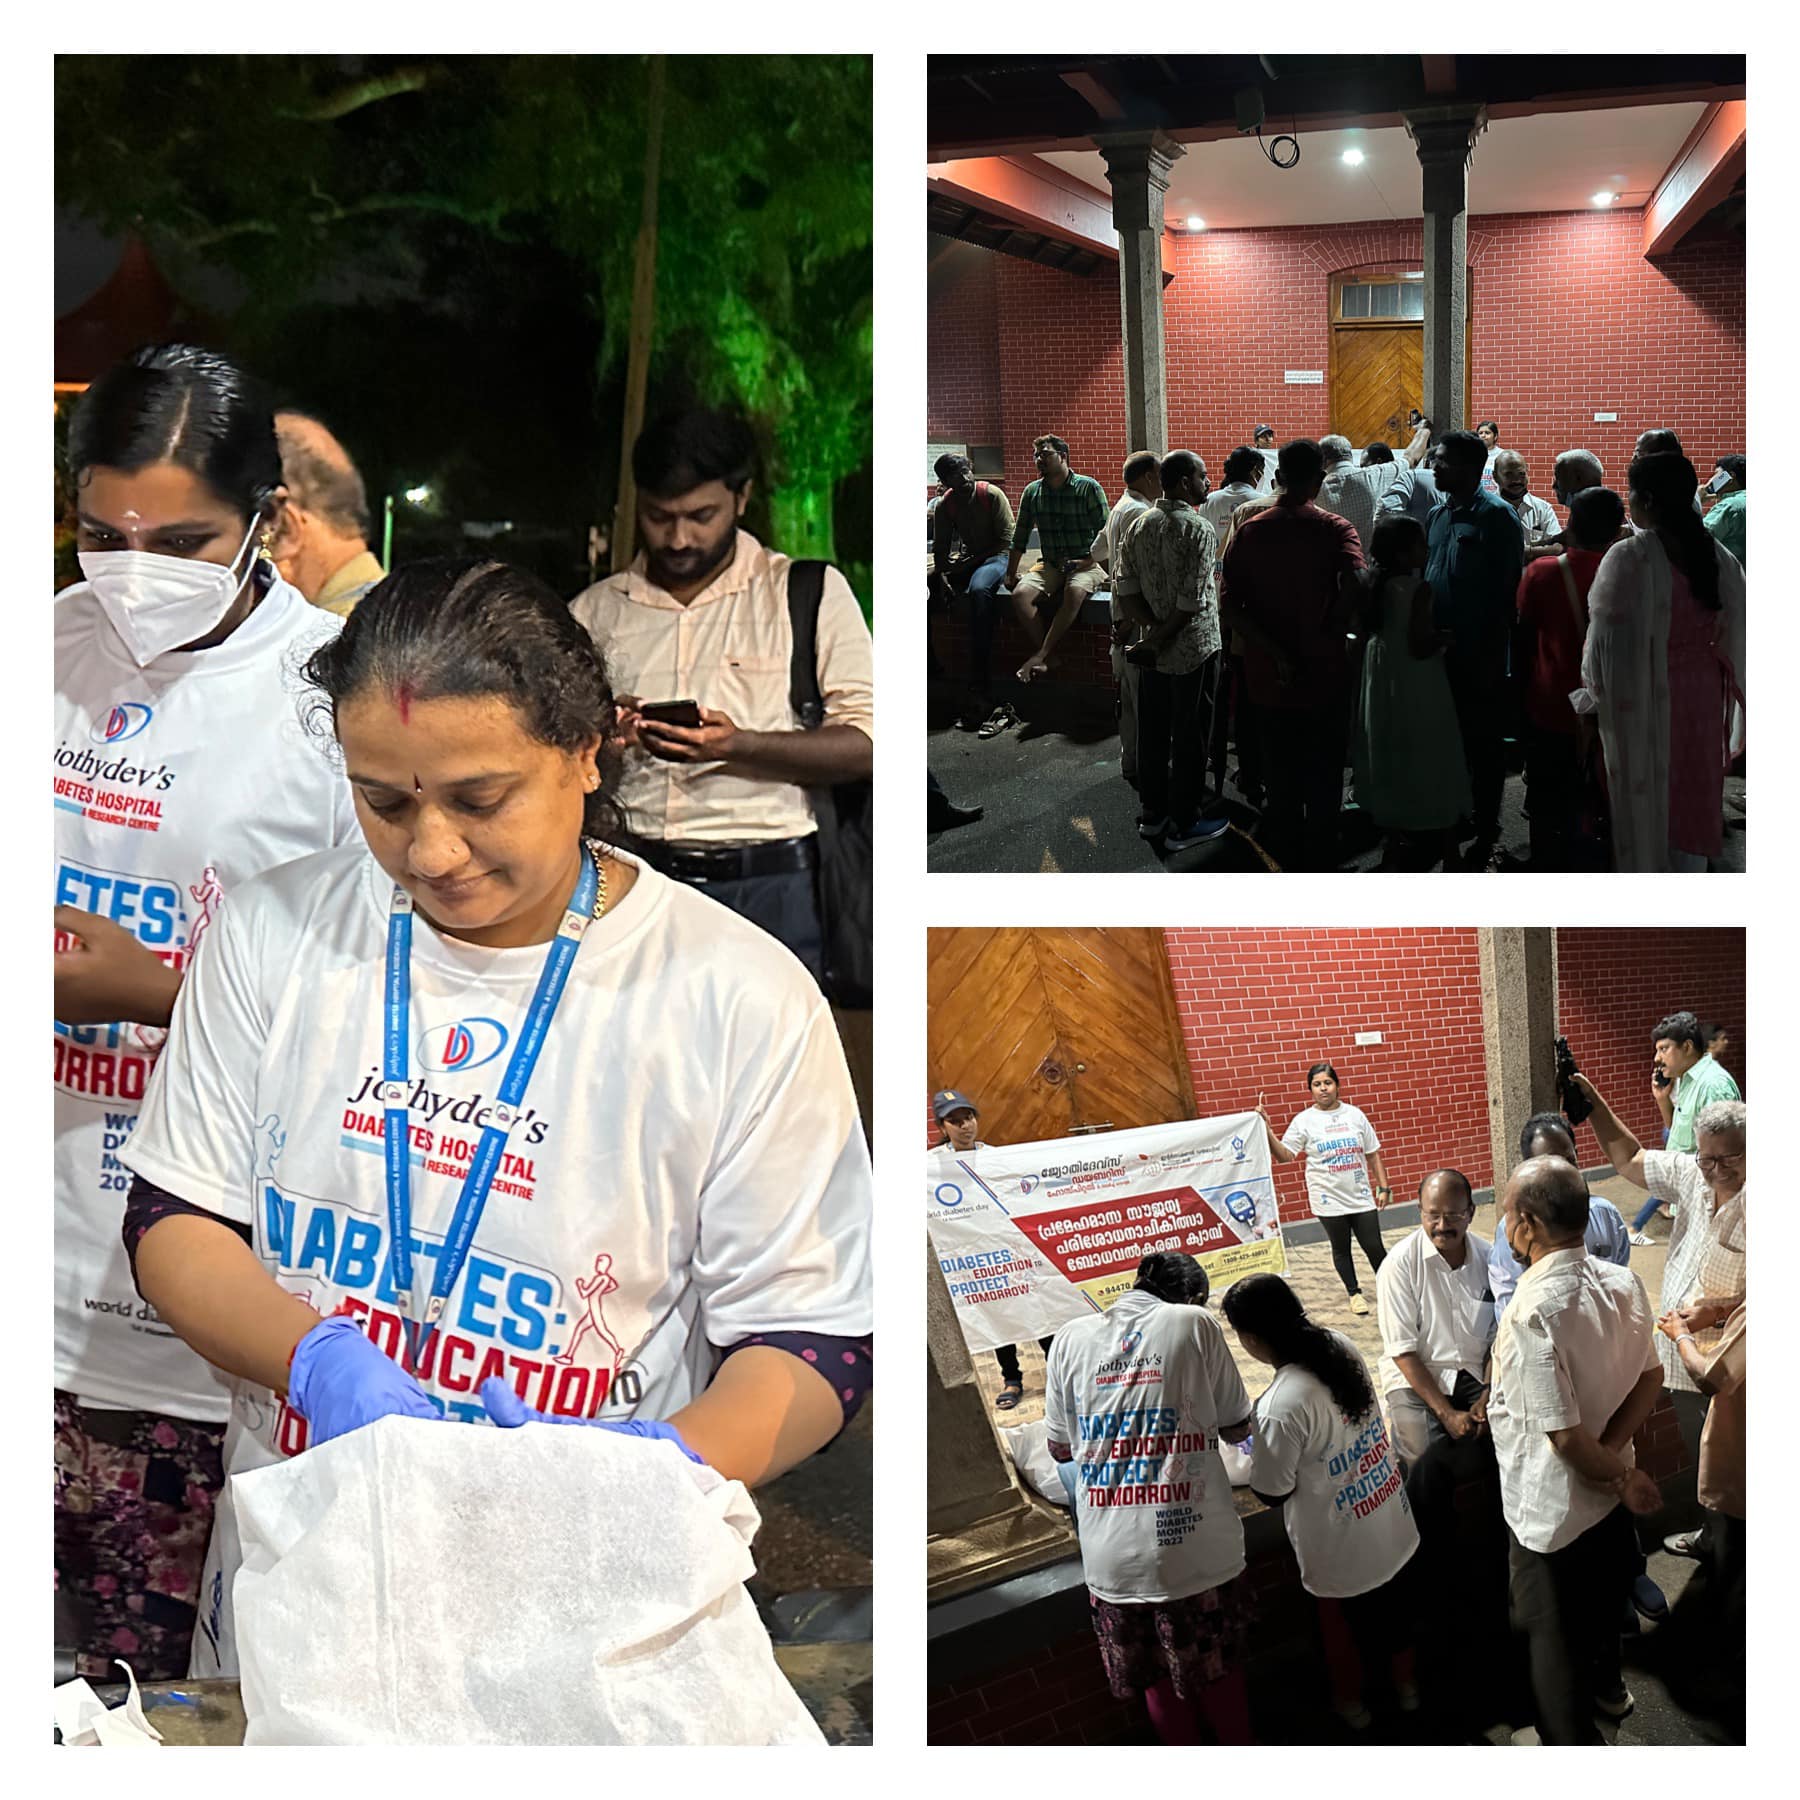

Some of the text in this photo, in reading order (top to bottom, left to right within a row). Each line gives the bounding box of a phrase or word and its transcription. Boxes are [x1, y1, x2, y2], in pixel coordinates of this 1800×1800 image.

[95, 788, 163, 818] HOSPITAL
[347, 1066, 549, 1144] johyde's
[342, 1110, 537, 1182] DIABTES HOSTAL
[489, 1178, 535, 1201] CENTRE
[265, 1186, 567, 1355] DIABES:
[941, 1249, 1014, 1274] DIABETES:
[973, 1259, 1033, 1279] EDUCATION
[950, 1275, 1009, 1297] PROTECT
[964, 1283, 1030, 1305] TOMORROW
[85, 1298, 133, 1317] world
[1095, 1353, 1162, 1376] jothydev's
[1128, 1369, 1162, 1380] HOSPITAL
[1111, 1433, 1205, 1460] EDUCATION
[1080, 1459, 1162, 1487] PROTECT
[1334, 1455, 1393, 1511] PROTECT
[1088, 1481, 1191, 1508] TOMORROW
[1156, 1506, 1193, 1519] WORLD
[1156, 1513, 1203, 1530] DIABETES
[1156, 1524, 1195, 1538] MONTH
[1157, 1537, 1184, 1548] 2022
